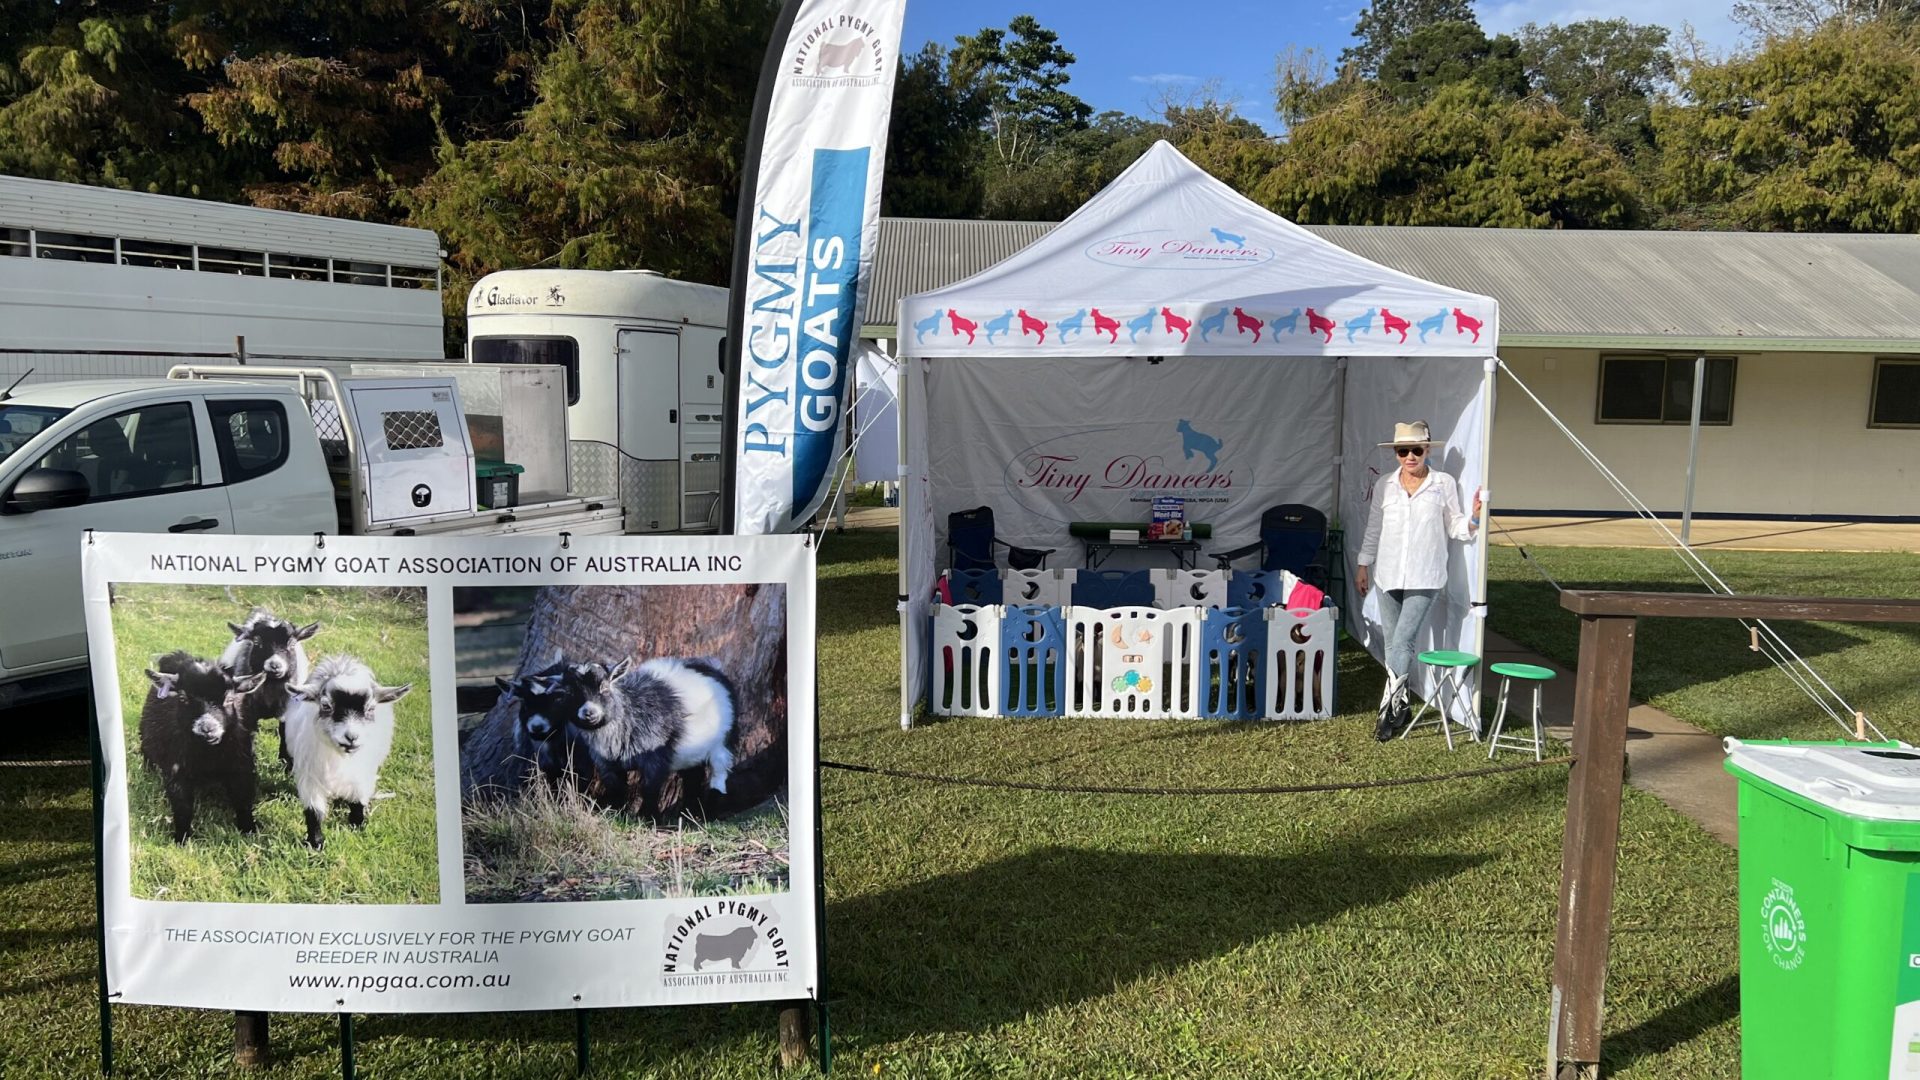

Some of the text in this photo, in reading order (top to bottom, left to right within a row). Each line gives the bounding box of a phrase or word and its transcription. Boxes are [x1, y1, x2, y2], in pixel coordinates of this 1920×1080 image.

[793, 15, 882, 75] NATIONAL PYGMY GOAT
[1097, 240, 1259, 260] Tiny Dancers
[487, 286, 539, 306] Gladiator
[744, 204, 801, 458] PYGMY
[800, 235, 844, 432] GOATS
[1018, 453, 1234, 504] Tiny Dancers
[151, 554, 742, 574] NATIONAL PYGMY GOAT ASSOCIATION OF AUSTRALIA INC
[1761, 889, 1807, 942] CONTAINERS
[165, 928, 636, 946] THE ASSOCIATION EXCLUSIVELY FOR THE PYGMY GOAT
[664, 901, 789, 973] NATIONAL PYGMY GOAT
[1761, 923, 1806, 970] FOR CHANGE
[296, 950, 499, 964] BREEDER IN AUSTRALIA
[289, 974, 511, 993] www.npgaa.com.au
[663, 975, 714, 987] ASSOCIATION
[716, 975, 727, 985] OF
[729, 973, 772, 985] AUSTRALIA
